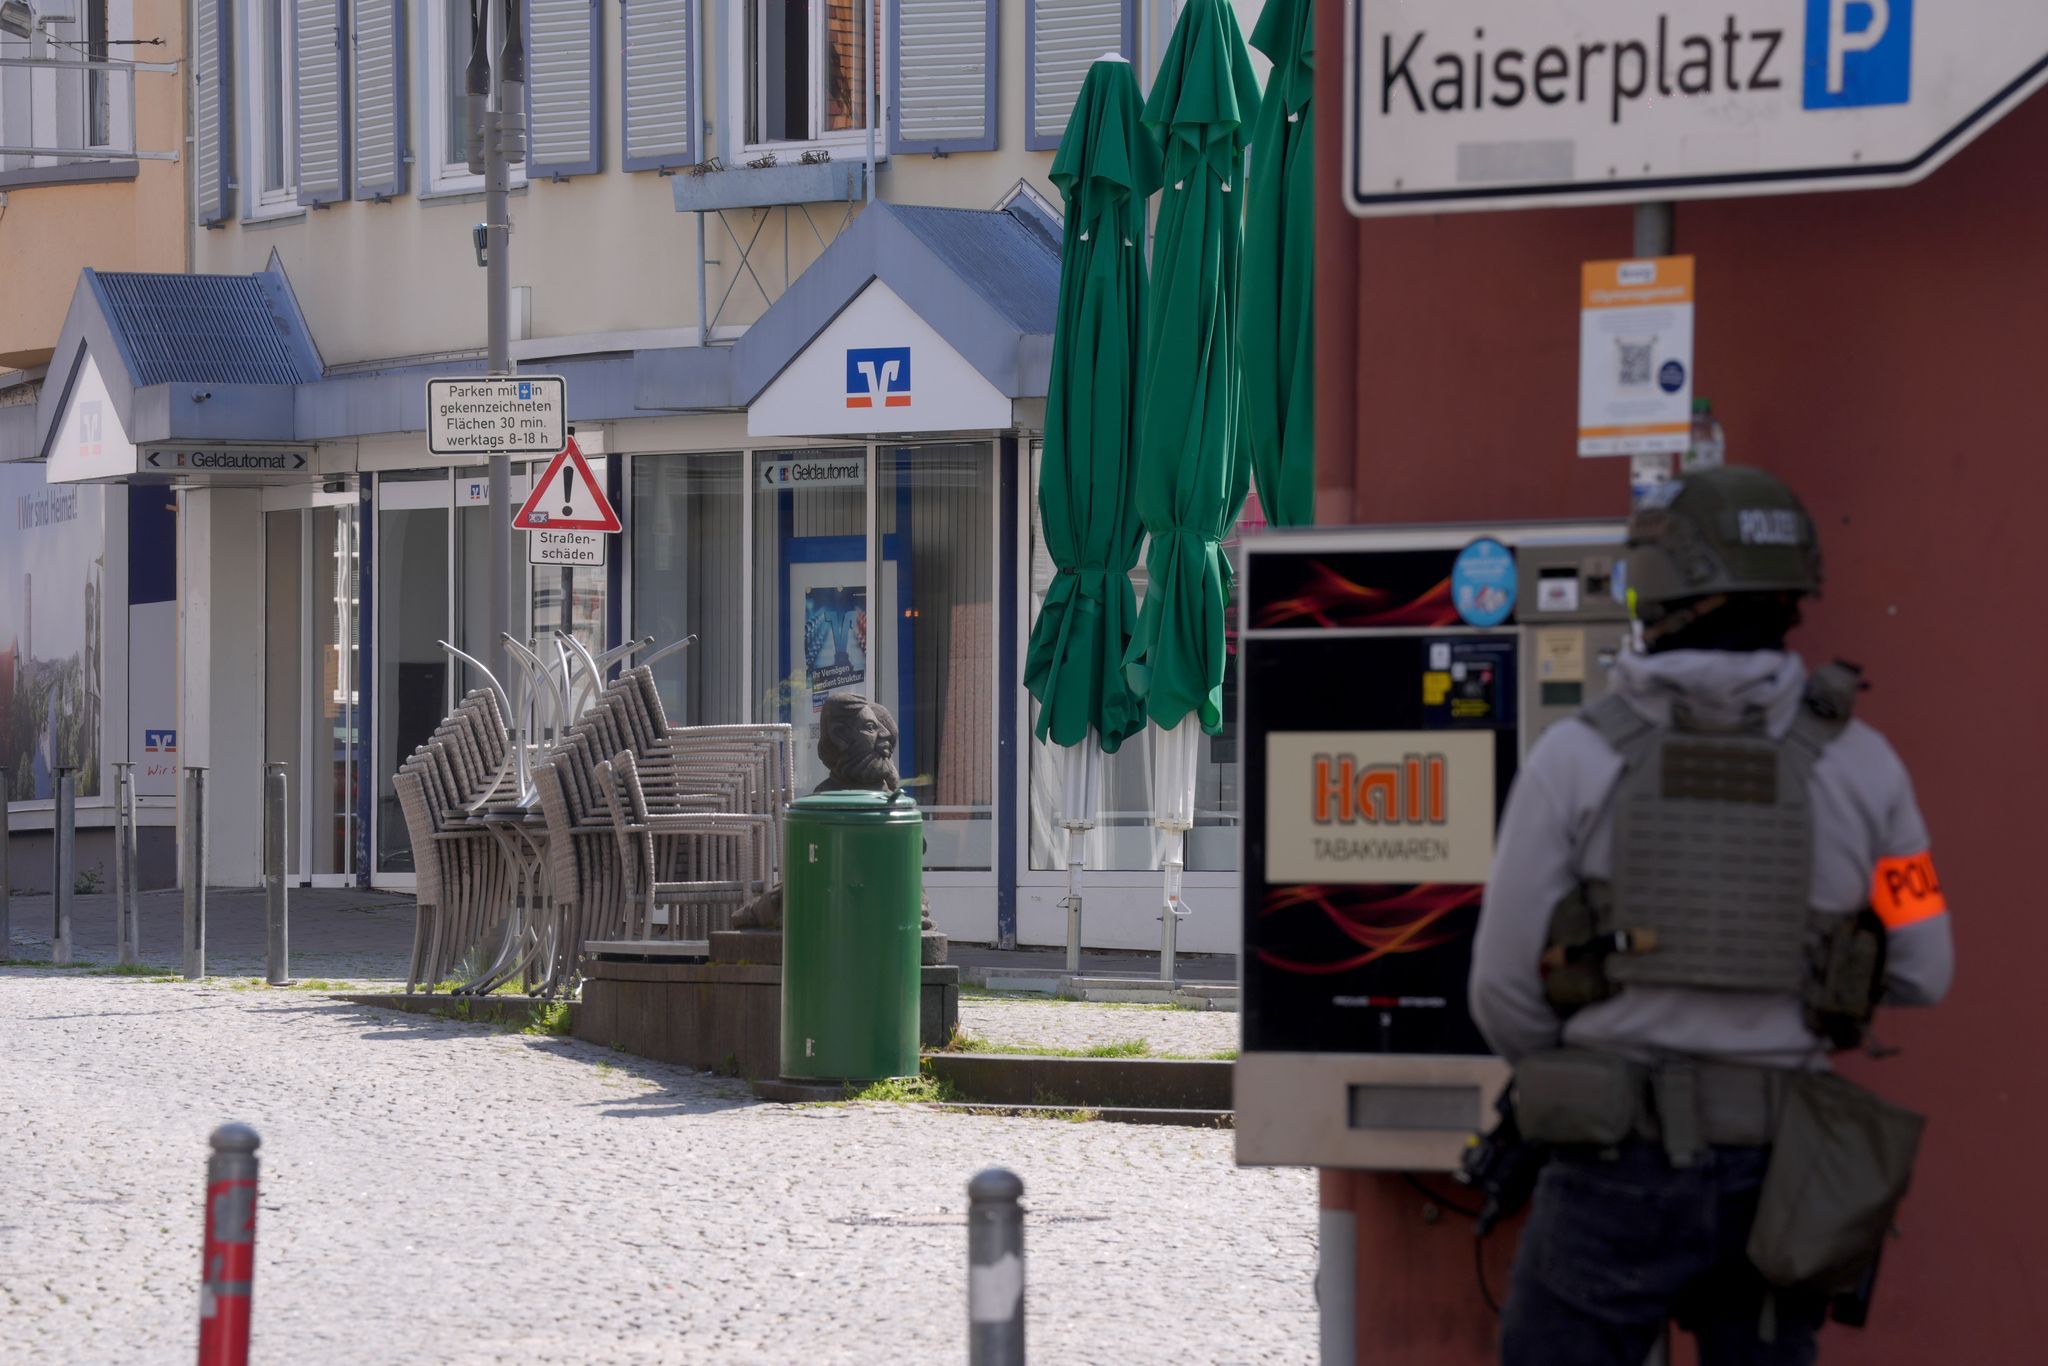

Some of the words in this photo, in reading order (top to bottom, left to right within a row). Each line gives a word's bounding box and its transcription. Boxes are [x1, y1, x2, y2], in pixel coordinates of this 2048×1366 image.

[1381, 14, 1784, 124] Kaiserplatz
[449, 385, 493, 397] Parken
[497, 386, 518, 397] mit
[531, 384, 543, 396] in
[440, 401, 552, 416] gekennzeichneten
[447, 417, 496, 430] Flächen
[500, 417, 515, 429] 30
[520, 416, 547, 429] min.
[446, 434, 504, 448] werktags
[509, 432, 536, 445] 8-18
[540, 432, 548, 444] h
[191, 451, 286, 468] Geldautomat
[792, 462, 860, 481] Geldautomat
[21, 493, 35, 530] Wir
[35, 490, 49, 527] sind
[50, 484, 79, 525] Heimat!
[540, 531, 597, 545] Straßen-
[542, 548, 595, 560] schäden
[812, 671, 822, 679] Ihr
[821, 665, 850, 677] Vermögen
[147, 763, 168, 776] Wir
[1312, 752, 1448, 827] Hall
[1313, 837, 1450, 861] TABAKWAREN
